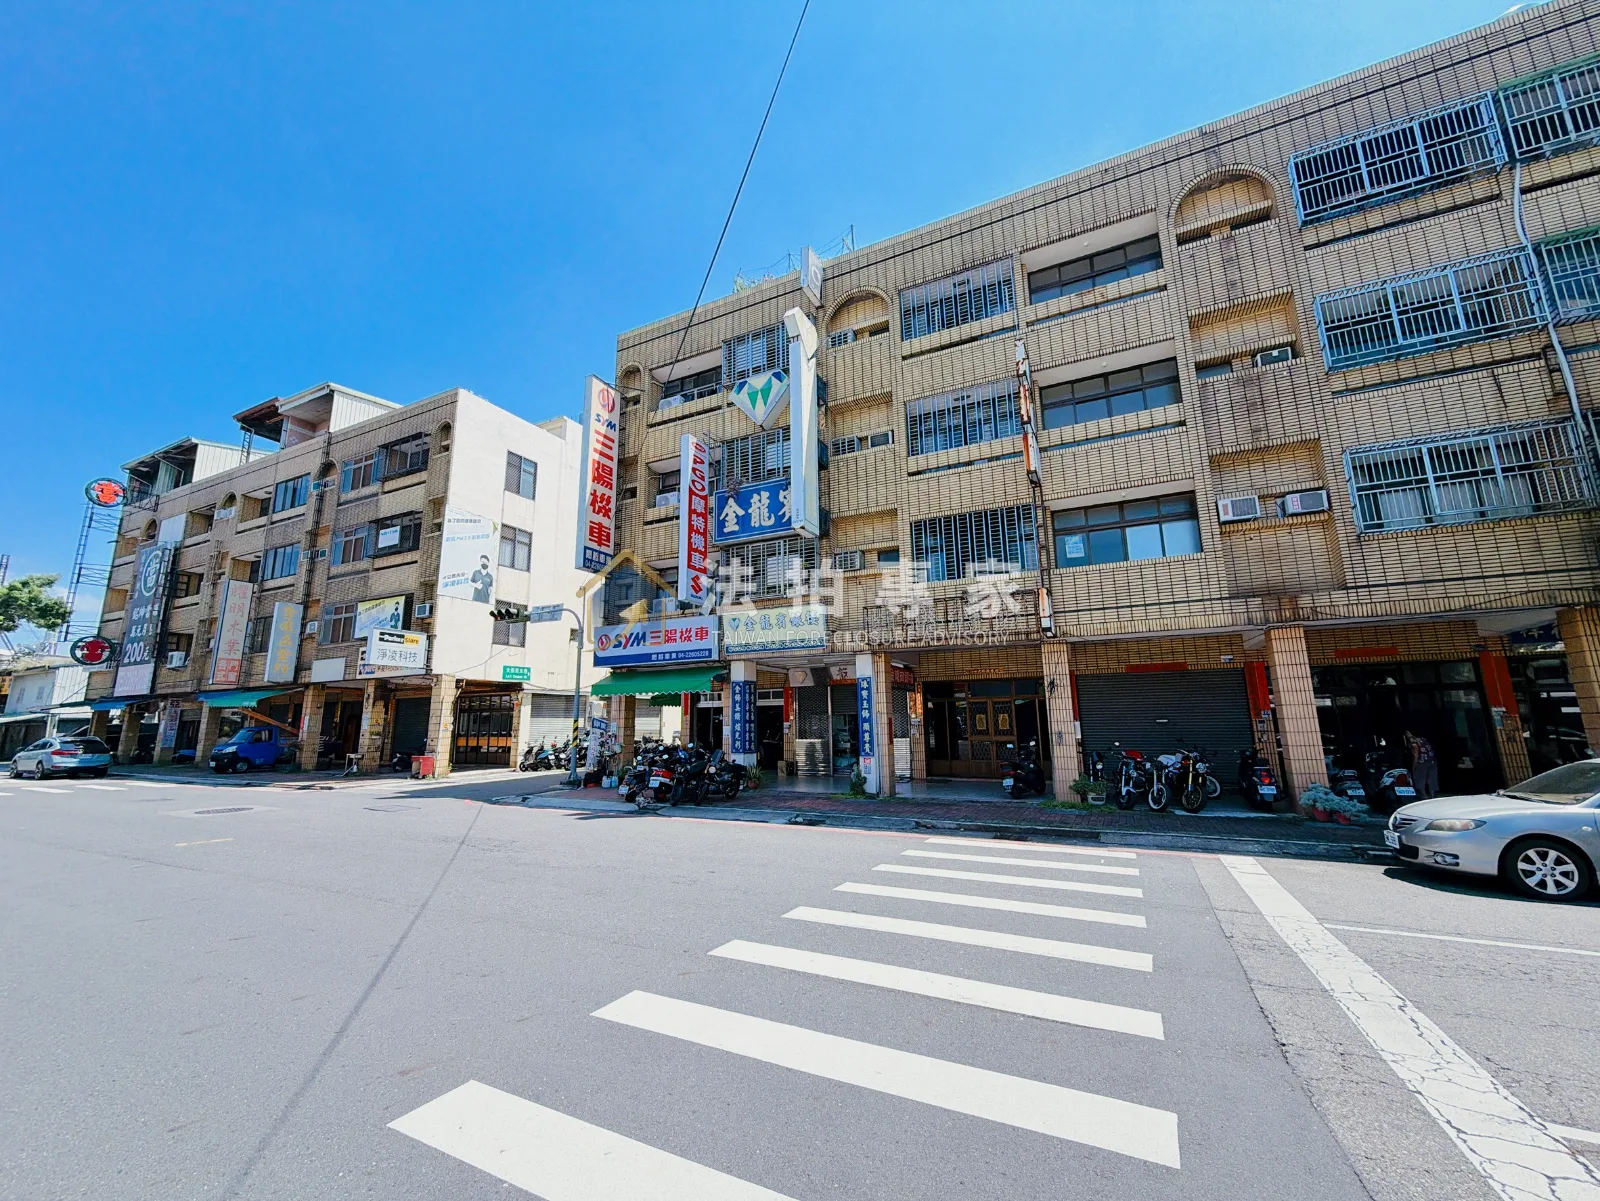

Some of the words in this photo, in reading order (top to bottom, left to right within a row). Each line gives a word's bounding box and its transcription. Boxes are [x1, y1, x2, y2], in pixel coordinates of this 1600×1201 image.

[595, 413, 616, 432] SYM
[588, 429, 615, 548] 三陽機車
[690, 495, 706, 570] 摩特機車
[613, 631, 646, 650] SYM
[649, 626, 709, 646] 三陽機車
[123, 641, 150, 664] 200元
[376, 648, 418, 663] 淨凌科技
